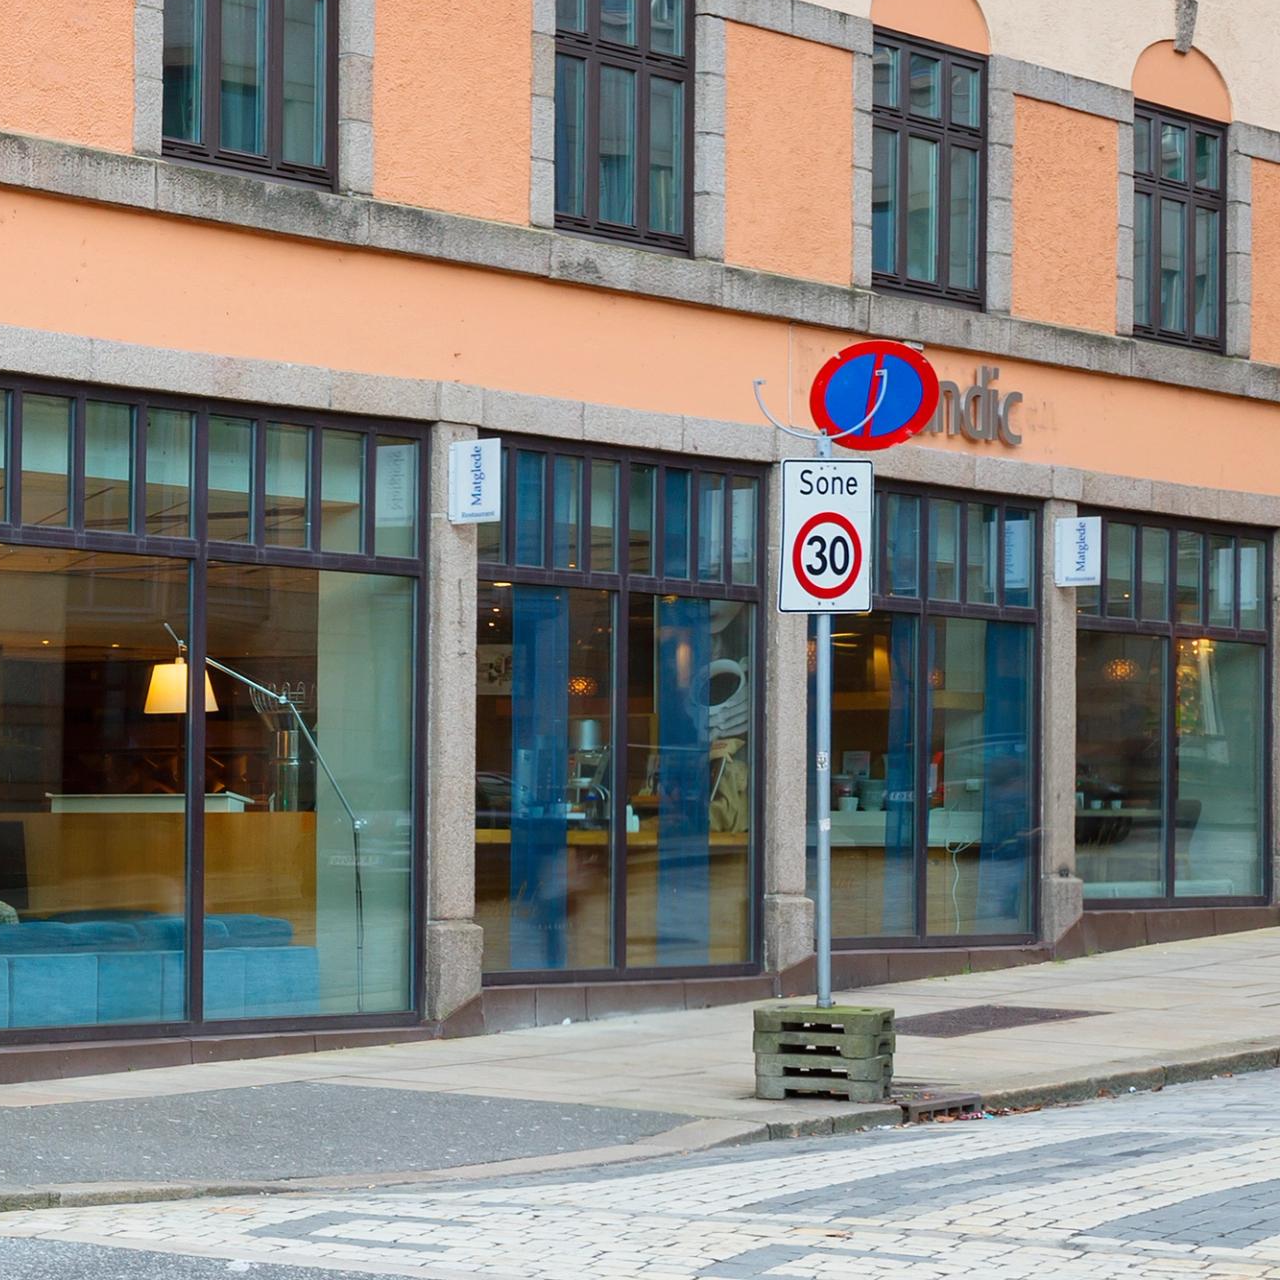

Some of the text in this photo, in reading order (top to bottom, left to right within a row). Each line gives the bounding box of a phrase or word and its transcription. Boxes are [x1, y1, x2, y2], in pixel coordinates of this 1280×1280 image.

[925, 365, 1024, 445] ndic
[470, 445, 486, 506] Matglede
[800, 469, 858, 496] Sone
[806, 535, 850, 576] 30
[1075, 522, 1090, 572] Matglede
